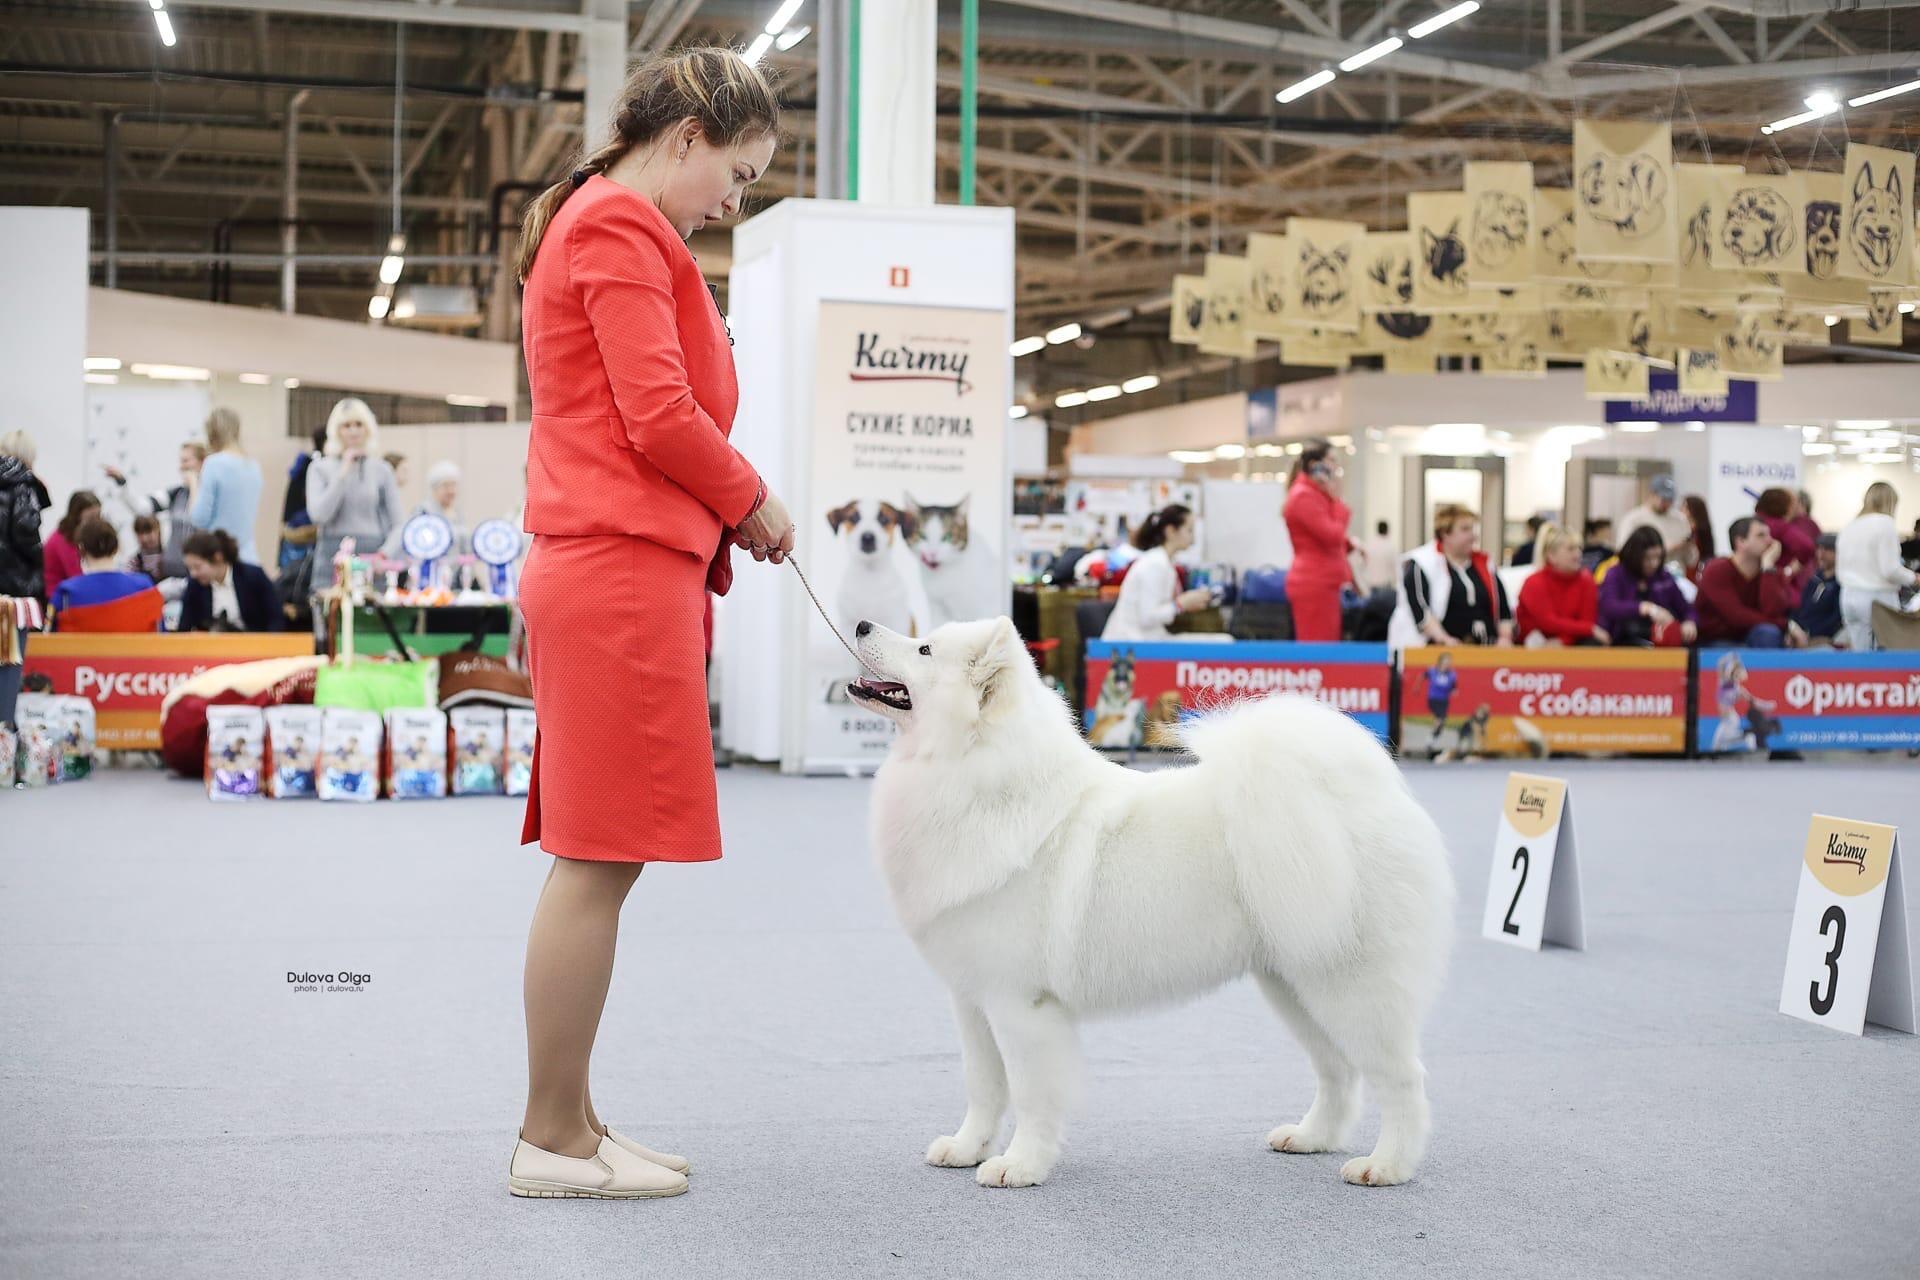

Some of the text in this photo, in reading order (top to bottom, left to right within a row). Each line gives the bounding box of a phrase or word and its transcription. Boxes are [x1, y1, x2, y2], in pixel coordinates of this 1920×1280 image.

[852, 332, 970, 397] Karmy
[847, 412, 974, 438] СУХИЕ КОРМА
[75, 665, 206, 702] Русски
[1176, 661, 1323, 693] Породные
[1493, 668, 1564, 697] Спорт
[1520, 688, 1674, 716] с собаками
[1824, 833, 1867, 875] Karmy
[1503, 846, 1529, 936] 2
[1809, 905, 1847, 1016] 3
